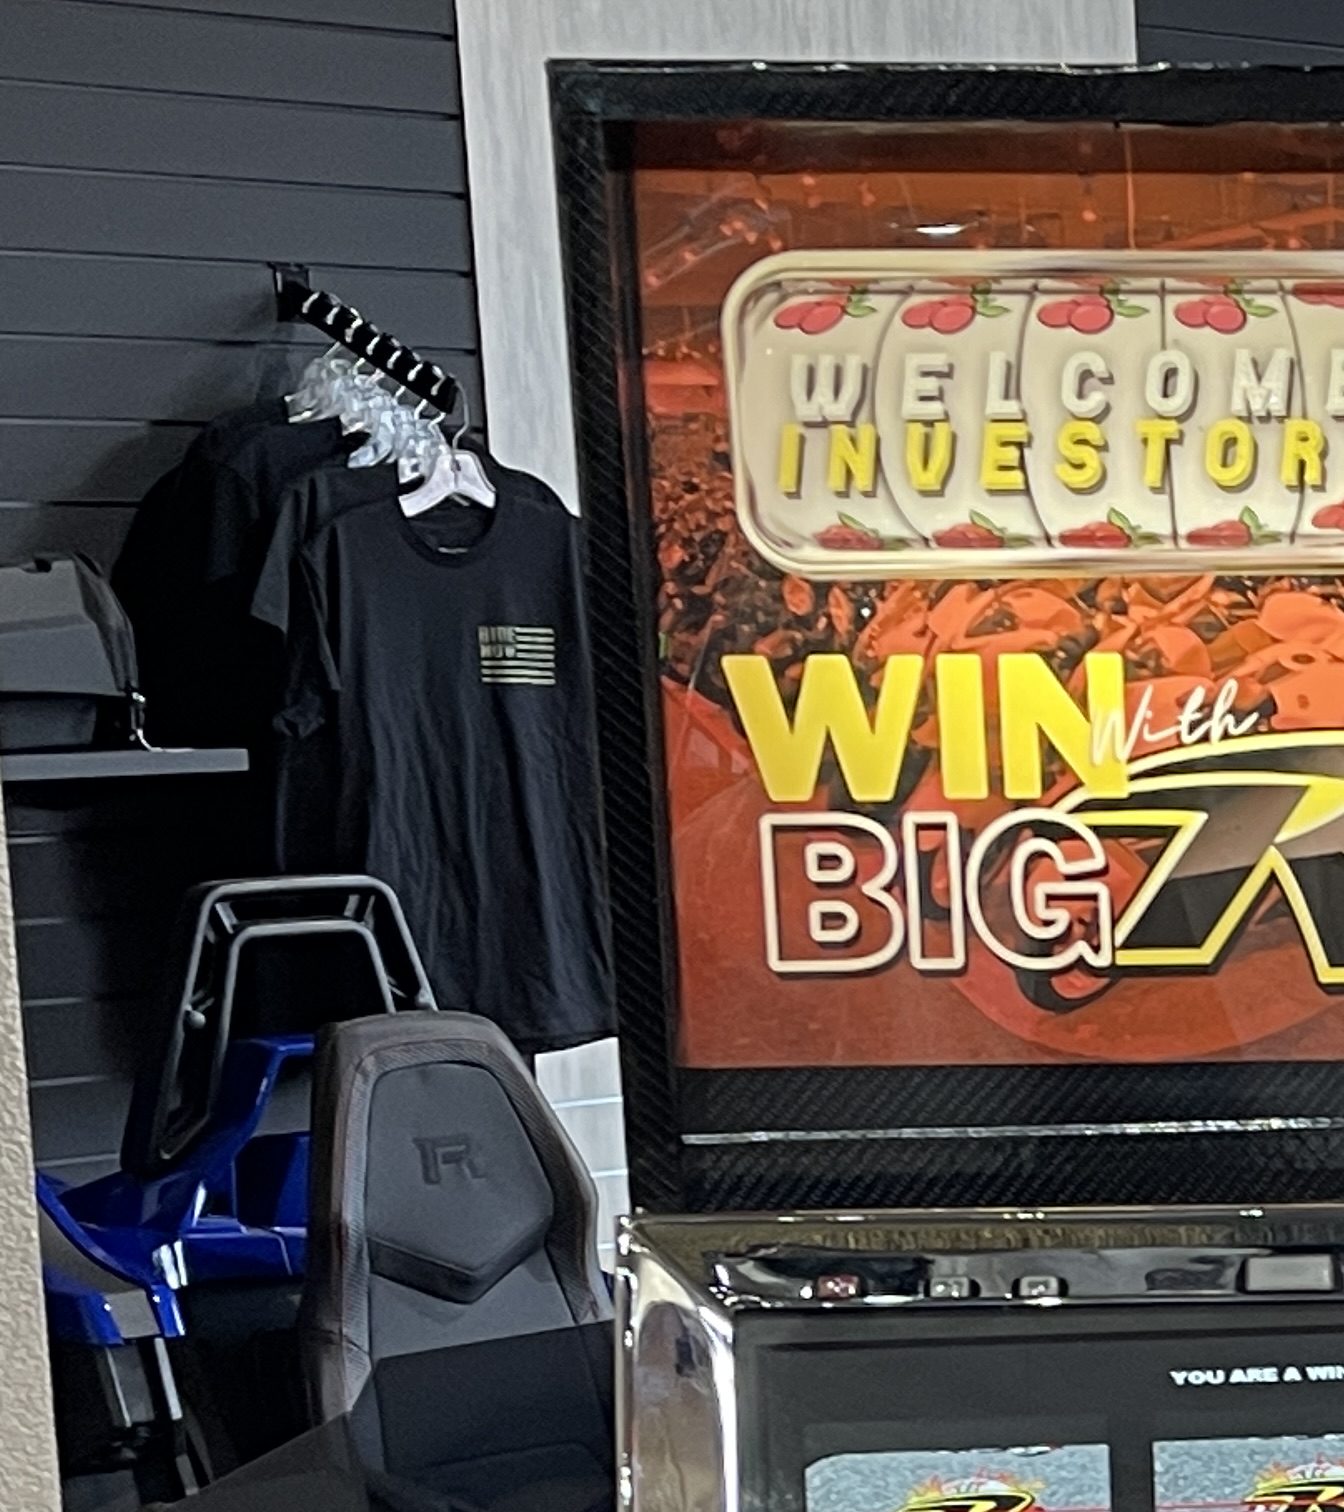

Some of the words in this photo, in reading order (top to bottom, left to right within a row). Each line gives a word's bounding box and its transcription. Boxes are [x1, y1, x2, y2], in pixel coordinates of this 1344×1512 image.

[721, 653, 1130, 801] WIN
[1088, 678, 1260, 768] With
[758, 808, 1115, 973] BIG
[1169, 1369, 1226, 1386] YOU
[1229, 1367, 1279, 1384] ARE
[1282, 1366, 1302, 1382] A
